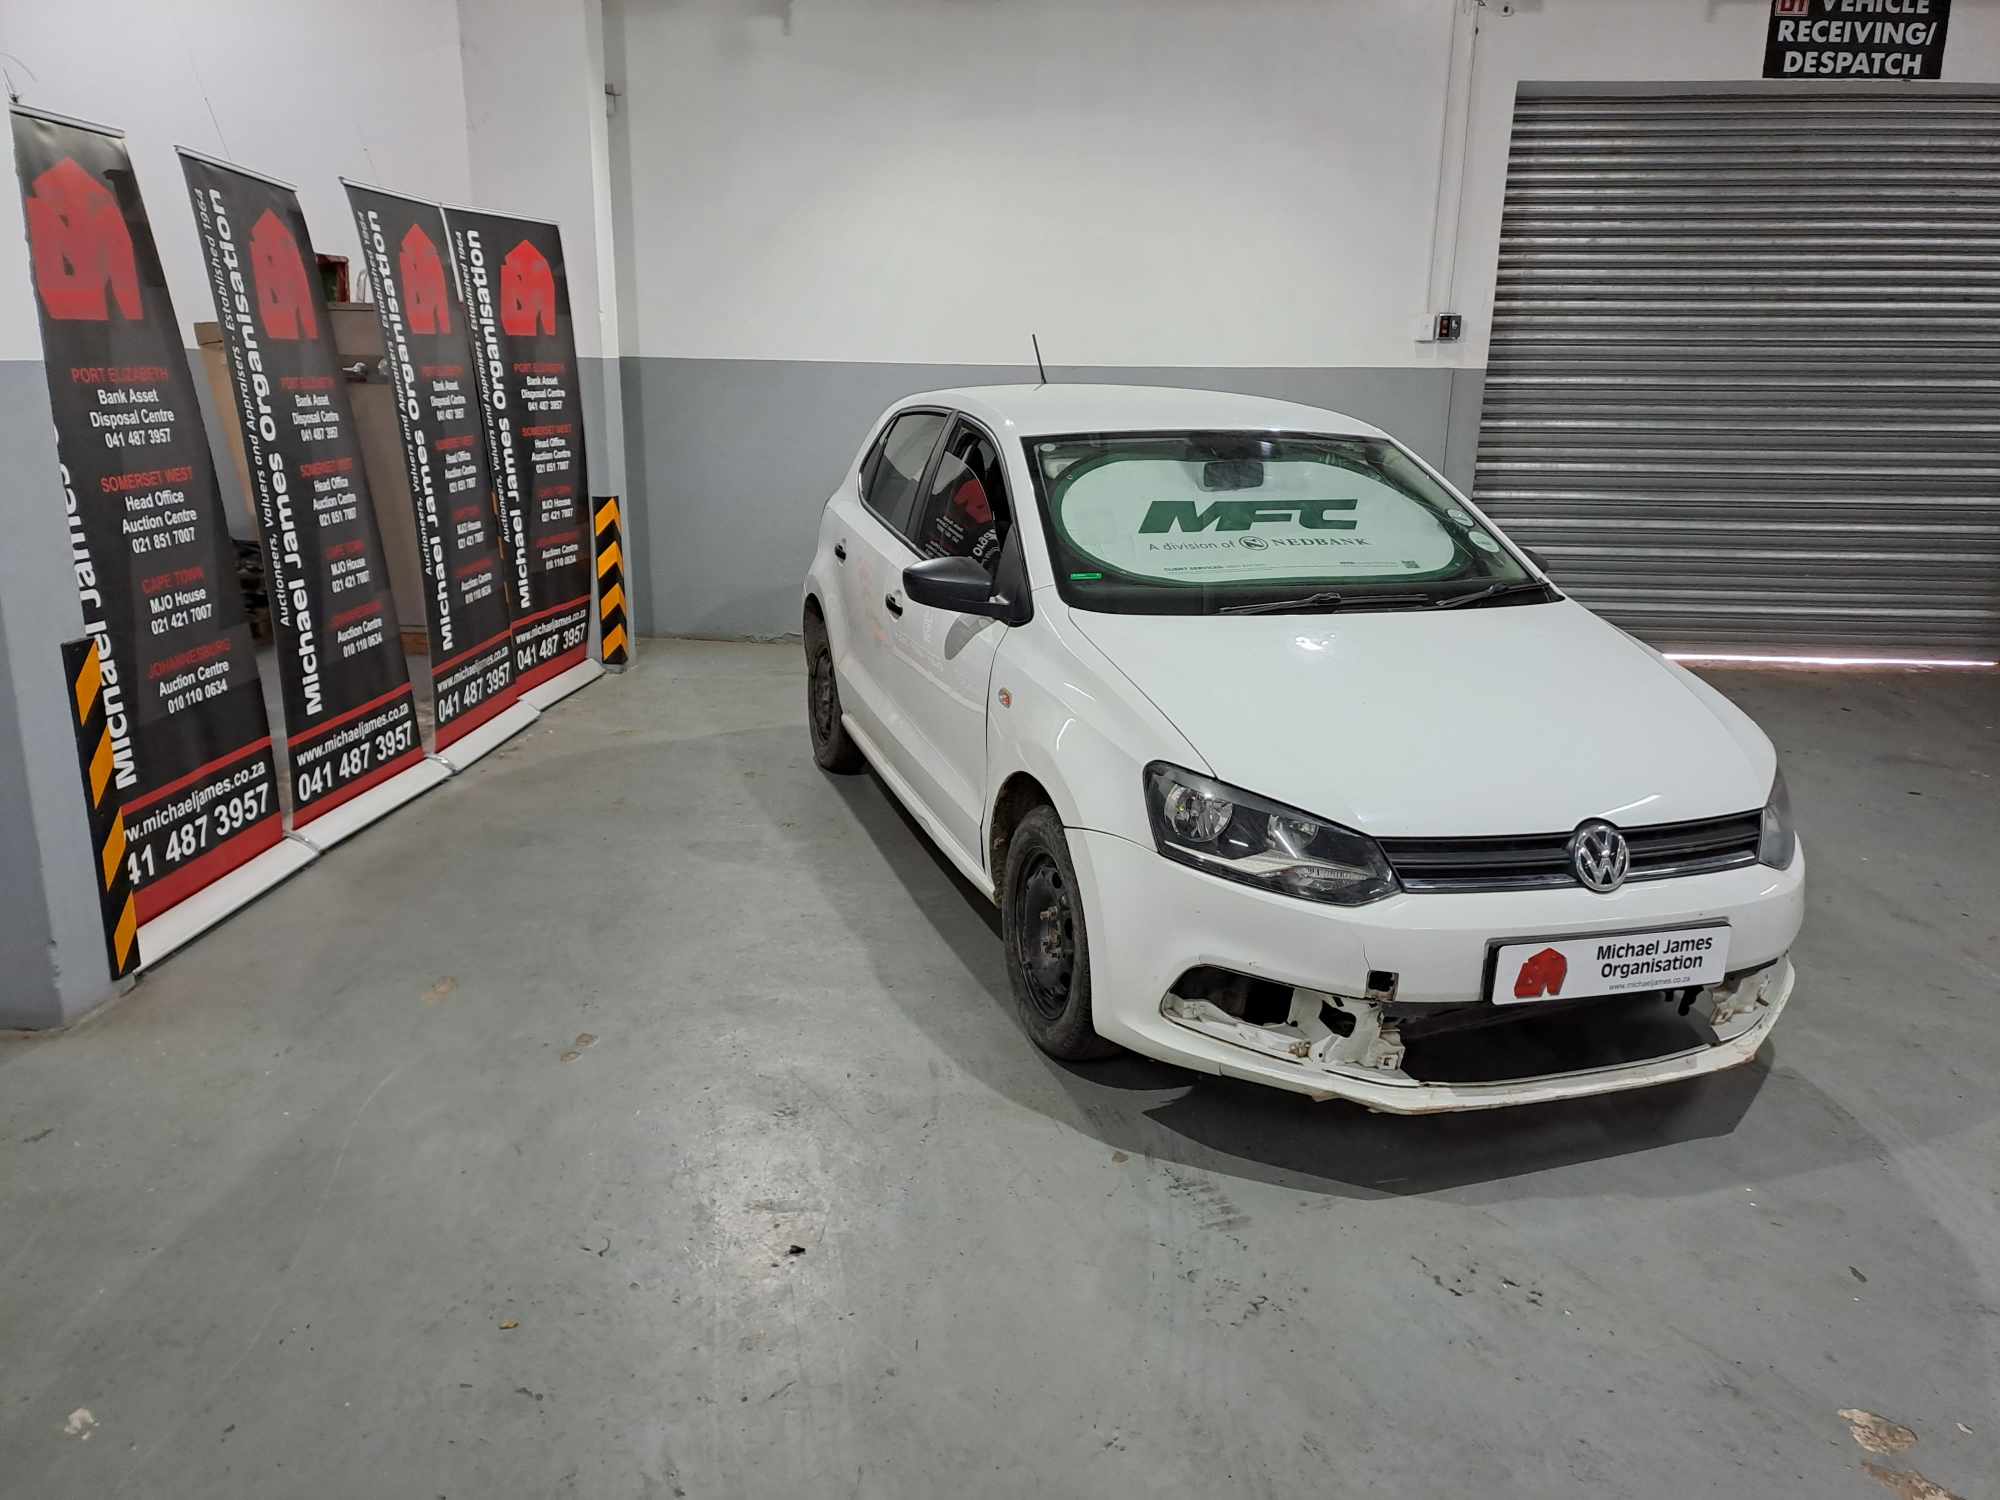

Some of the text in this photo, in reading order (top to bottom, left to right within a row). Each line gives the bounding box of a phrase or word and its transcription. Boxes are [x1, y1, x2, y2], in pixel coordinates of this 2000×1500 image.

[1823, 0, 1930, 14] VEHICLE
[1777, 20, 1938, 45] RECEIVING/
[1783, 50, 1923, 75] DESPATCH
[205, 235, 236, 332] Established
[71, 367, 103, 383] PORT
[232, 345, 257, 432] Appraisers
[97, 389, 160, 405] Bank Asset
[89, 408, 175, 430] Disposal Centre
[367, 209, 454, 651] Michael James Organisation
[466, 229, 531, 609] Michael James Organisation
[105, 428, 172, 449] 041 487 3957
[208, 188, 323, 716] Michael James Organisation
[249, 433, 263, 466] and
[101, 465, 193, 493] SOMERSET WEST
[125, 489, 185, 512] Head Office
[257, 469, 275, 528] Valuers
[122, 508, 198, 535] Auction Centre
[1138, 498, 1358, 534] MFC
[132, 526, 196, 554] 021 851 7007
[1149, 535, 1373, 552] A division of NEDBANK
[271, 533, 291, 627] Auctioneers,
[150, 587, 207, 613] MJO House
[151, 603, 213, 635] 021 421 7007
[517, 622, 587, 671] 041 487 3957
[158, 659, 230, 697] Auction Centre
[438, 661, 511, 723] 041 487 3957
[86, 619, 138, 790] Michael
[167, 678, 228, 715] 010 110 0634
[296, 701, 410, 767] www.michaeljames.co.za
[299, 719, 412, 802] 041 487 3957
[124, 760, 266, 843] w.michaeljames.co.za
[165, 816, 209, 863] 487
[215, 782, 270, 837] 3957
[1596, 936, 1713, 961] Michael James
[1601, 954, 1703, 979] Organisation
